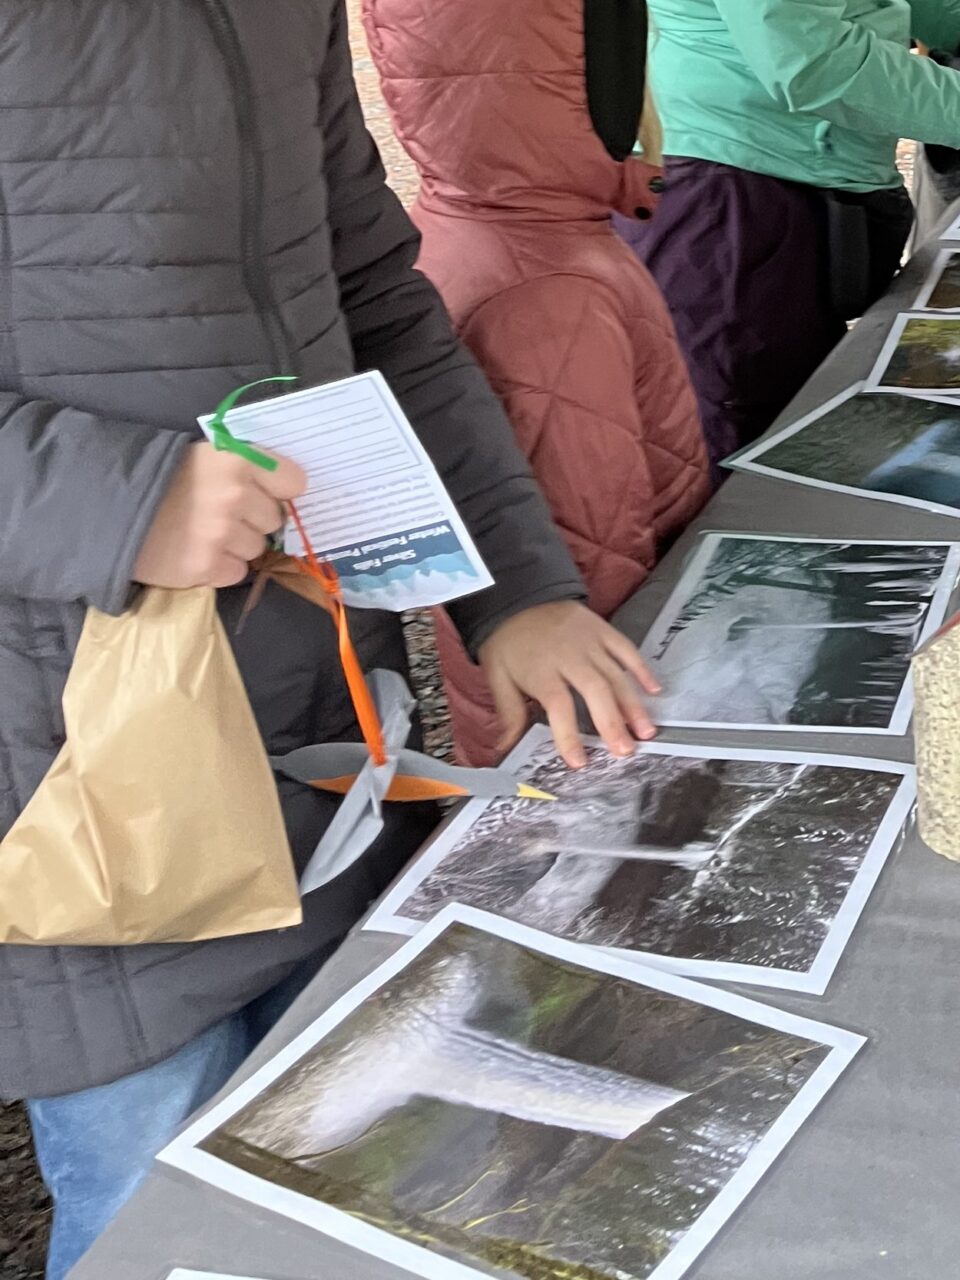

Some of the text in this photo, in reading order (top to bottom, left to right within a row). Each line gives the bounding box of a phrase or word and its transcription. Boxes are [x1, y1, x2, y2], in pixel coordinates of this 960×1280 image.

[407, 524, 450, 542] Winter
[360, 535, 407, 555] Festival
[380, 548, 416, 565] Silver
